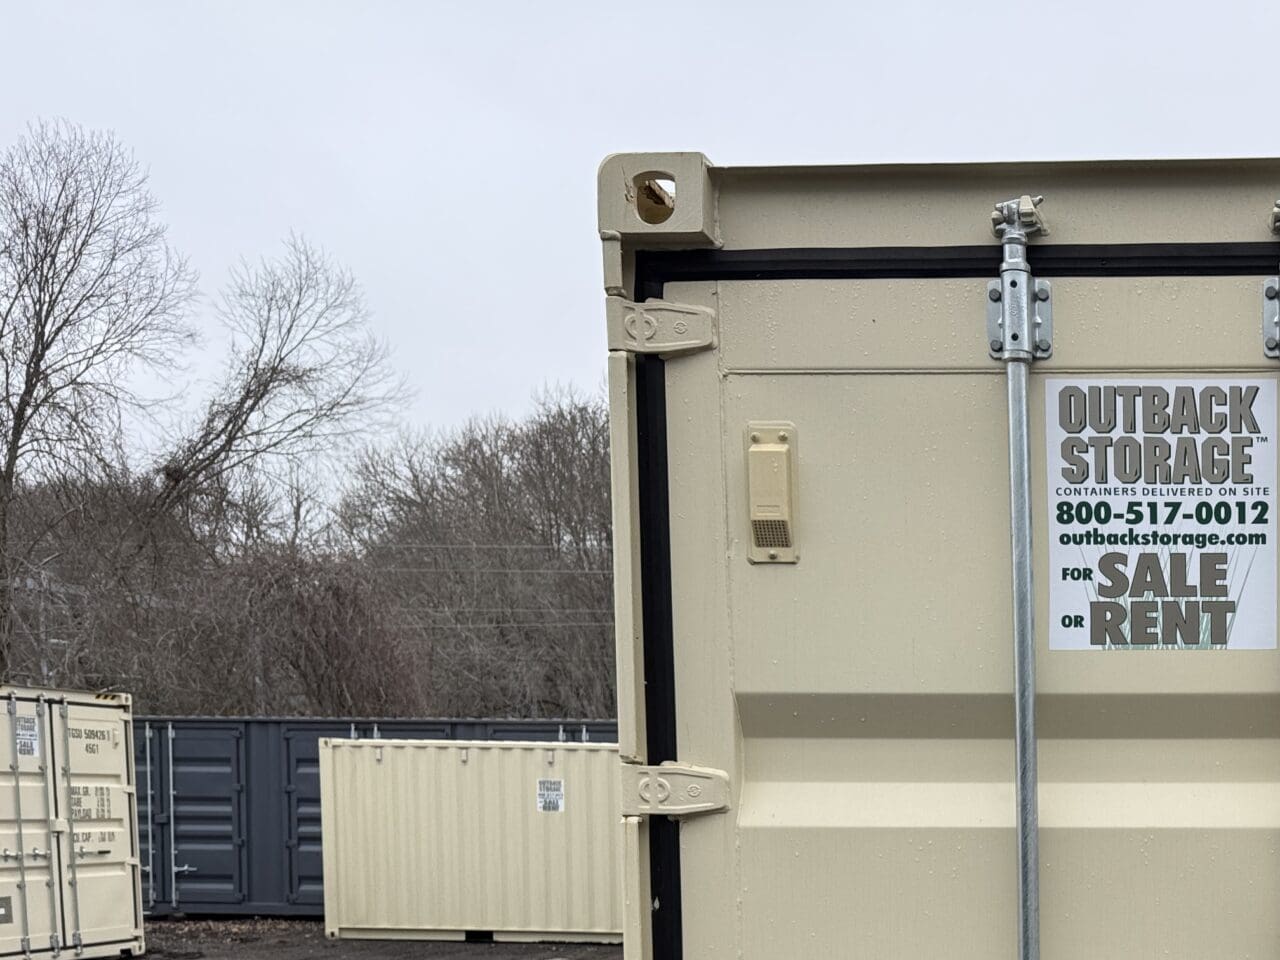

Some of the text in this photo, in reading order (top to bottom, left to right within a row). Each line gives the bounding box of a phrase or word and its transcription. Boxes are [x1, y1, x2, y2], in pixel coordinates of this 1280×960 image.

[1058, 385, 1261, 434] OUTBACK
[1060, 436, 1254, 485] STORAGE
[1055, 487, 1270, 497] CONTAINERS DELIVERED ON SITE
[1055, 501, 1269, 525] 800-517-0012
[1059, 528, 1267, 549] outbackstorage.com
[1061, 552, 1229, 599] FOR SALE
[1061, 600, 1236, 646] OR RENT
